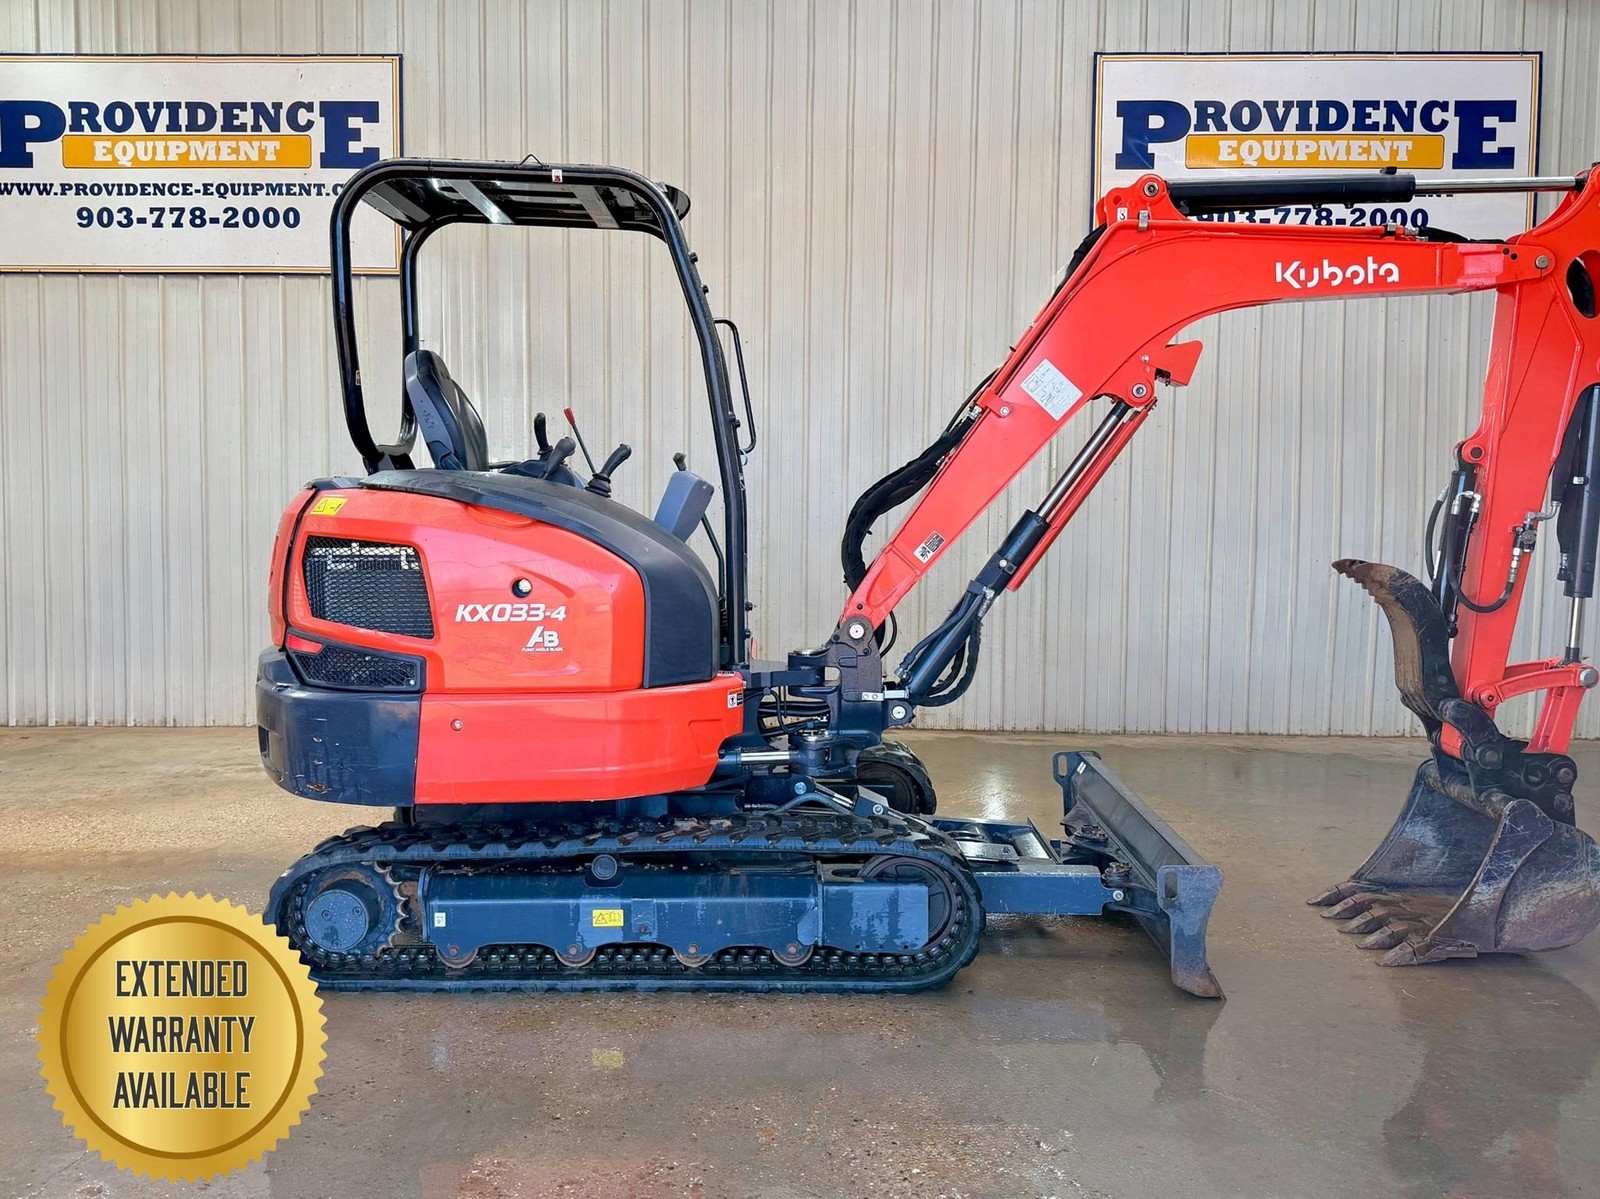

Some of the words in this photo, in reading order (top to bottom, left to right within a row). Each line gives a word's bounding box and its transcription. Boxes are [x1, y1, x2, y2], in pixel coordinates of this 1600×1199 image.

[0, 100, 379, 168] PROVIDENCE
[1115, 100, 1517, 169] PROVIDENCE
[93, 140, 281, 167] EQUIPMENT
[1218, 140, 1413, 166] EQUIPMENT
[76, 206, 301, 228] 903-778-2000
[1275, 256, 1400, 289] Kubota
[455, 603, 566, 622] KX033-4
[526, 625, 560, 648] AB
